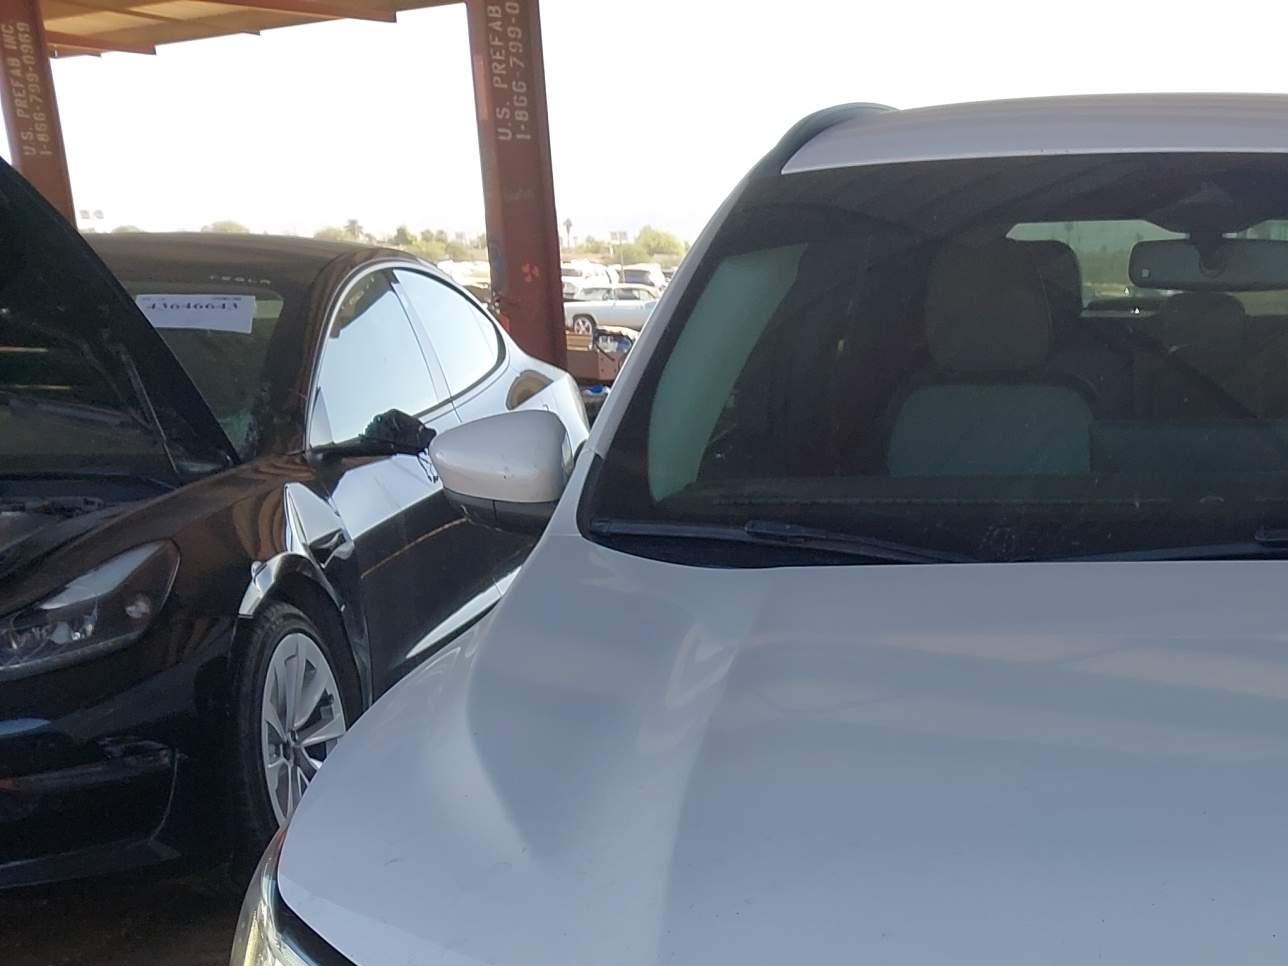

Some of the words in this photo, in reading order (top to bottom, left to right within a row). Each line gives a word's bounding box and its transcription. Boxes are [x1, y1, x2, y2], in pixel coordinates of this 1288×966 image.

[487, 5, 509, 89] PREFAB
[7, 57, 30, 120] PREFAB
[20, 127, 37, 157] U.S.
[495, 101, 513, 141] U.S.
